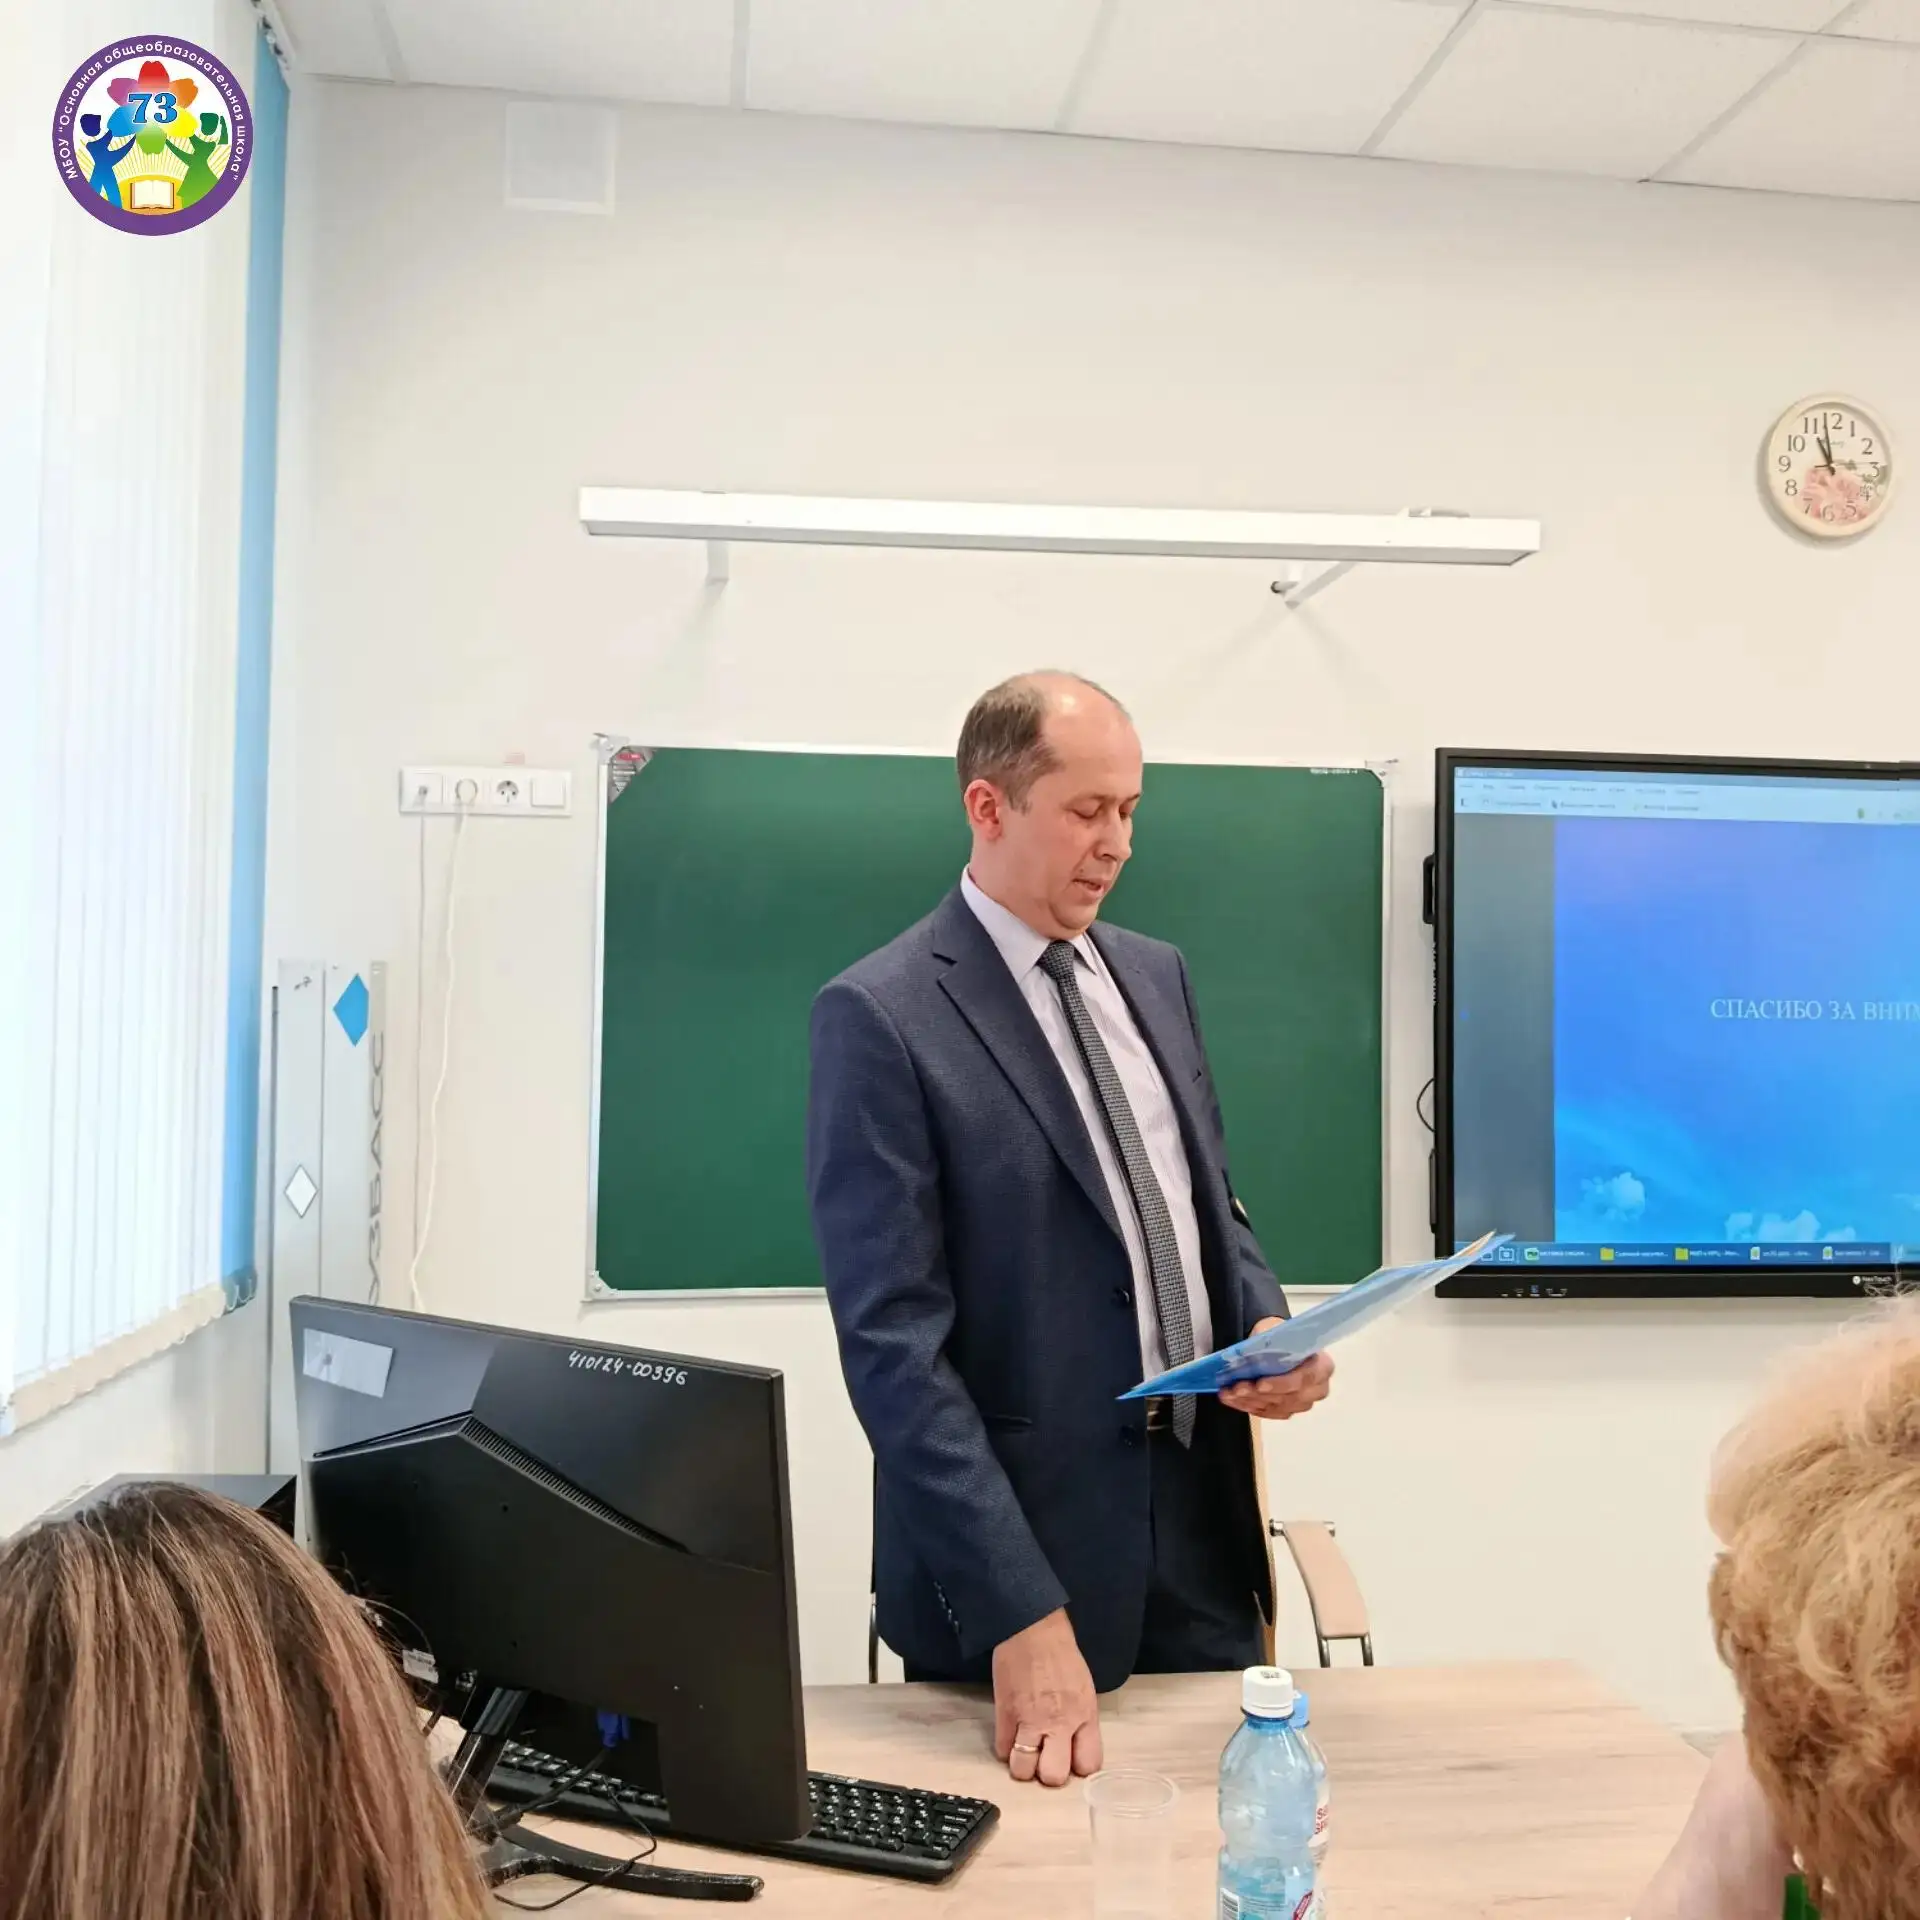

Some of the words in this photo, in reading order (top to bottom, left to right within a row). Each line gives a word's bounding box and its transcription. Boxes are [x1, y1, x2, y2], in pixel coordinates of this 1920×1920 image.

[1804, 416, 1818, 434] 11
[1850, 420, 1856, 437] 1
[1787, 434, 1806, 453] 10
[1860, 437, 1873, 455] 2
[1777, 455, 1792, 473] 9
[1869, 461, 1881, 478] 3
[1784, 478, 1798, 497] 8
[1803, 497, 1813, 515] 7
[1822, 504, 1835, 522] 6
[1845, 500, 1857, 517] 5
[1710, 998, 1822, 1020] СПАСИБО
[1829, 1000, 1856, 1020] ЗА
[568, 1350, 688, 1385] 410124-00396
